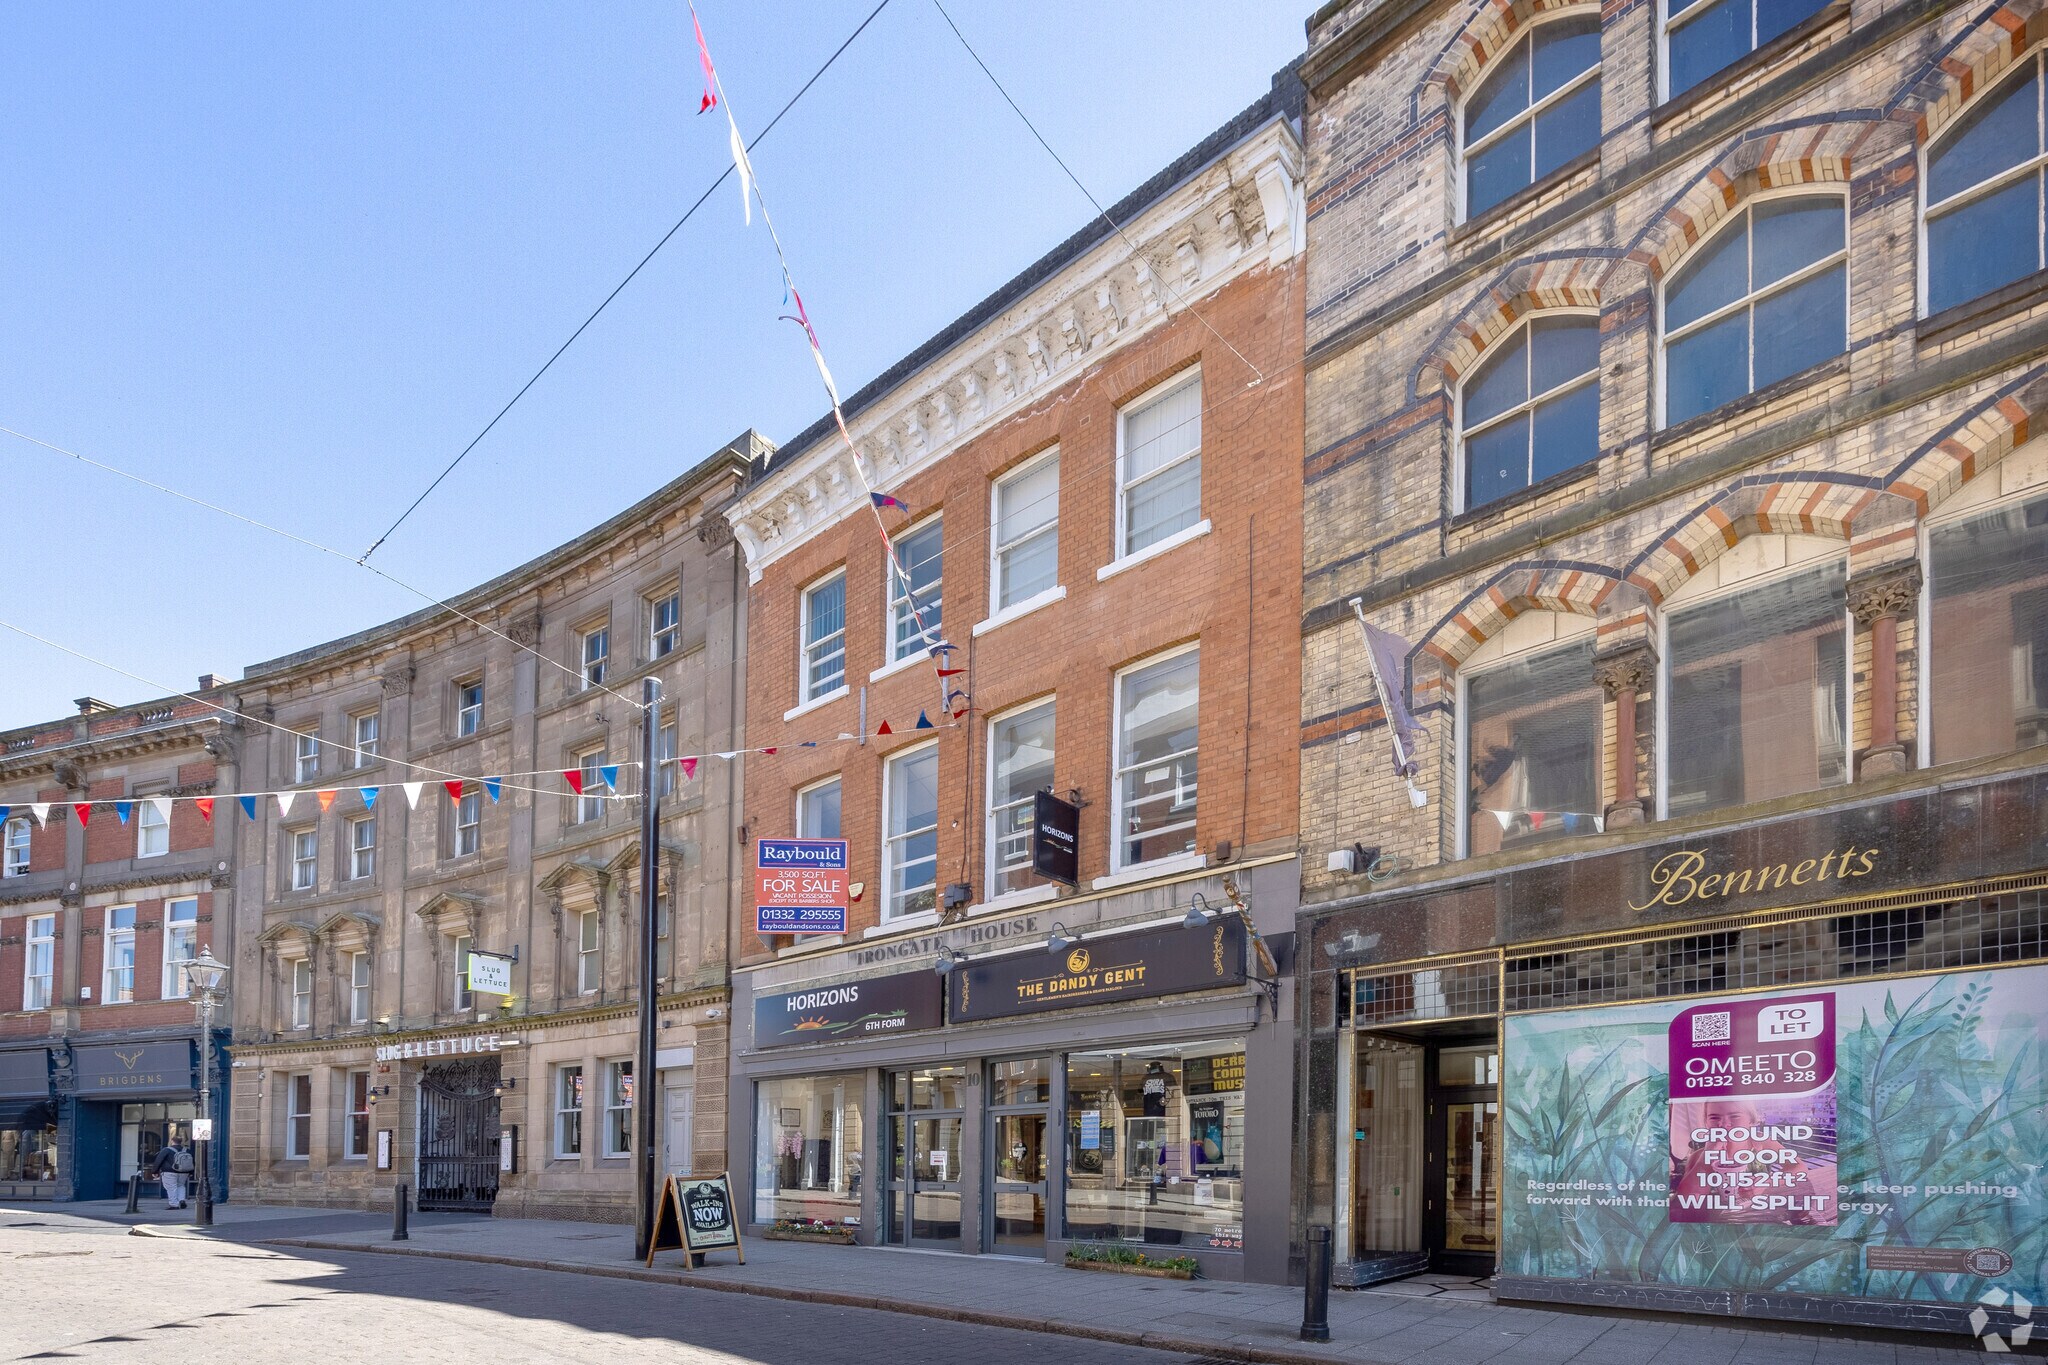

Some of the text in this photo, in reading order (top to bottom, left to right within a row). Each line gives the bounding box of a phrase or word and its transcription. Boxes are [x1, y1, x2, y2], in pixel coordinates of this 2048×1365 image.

[1042, 824, 1074, 842] HORIZONS
[764, 846, 841, 862] Raybould
[778, 870, 800, 878] 3,500
[1628, 846, 1878, 910] Bennetts
[764, 879, 796, 892] FOR
[802, 880, 840, 892] SALE
[762, 910, 841, 920] 01332 295555
[857, 916, 1038, 966] IRONGATE HOUSE
[481, 965, 501, 974] SLUG
[474, 978, 508, 988] LETTUCE
[1017, 966, 1146, 997] THE DANDY GENT
[787, 986, 859, 1012] HORIZONS
[1775, 1008, 1806, 1021] TO
[865, 1018, 905, 1031] 6TH FORM
[1770, 1022, 1811, 1035] LET
[376, 1036, 500, 1062] SLUG & LETTUCE
[1685, 1050, 1816, 1076] OMEETO
[100, 1074, 162, 1085] BRIGDENS
[967, 1072, 980, 1086] 10
[1214, 1079, 1245, 1090] MUS
[1686, 1071, 1816, 1088] 01332 840 328
[1194, 1109, 1219, 1118] TOTORO
[1691, 1125, 1813, 1142] GROUND
[1704, 1149, 1798, 1164] FLOOR
[1527, 1180, 1666, 1192] Regardless of the
[1696, 1172, 1807, 1188] 10,152ft²
[1862, 1181, 1917, 1197] keep
[1925, 1182, 2017, 1198] pushing
[1526, 1194, 1670, 1207] forward with that
[1677, 1194, 1830, 1211] WILL SPLIT
[693, 1207, 723, 1221] NOW
[1838, 1202, 1894, 1215] ergy.
